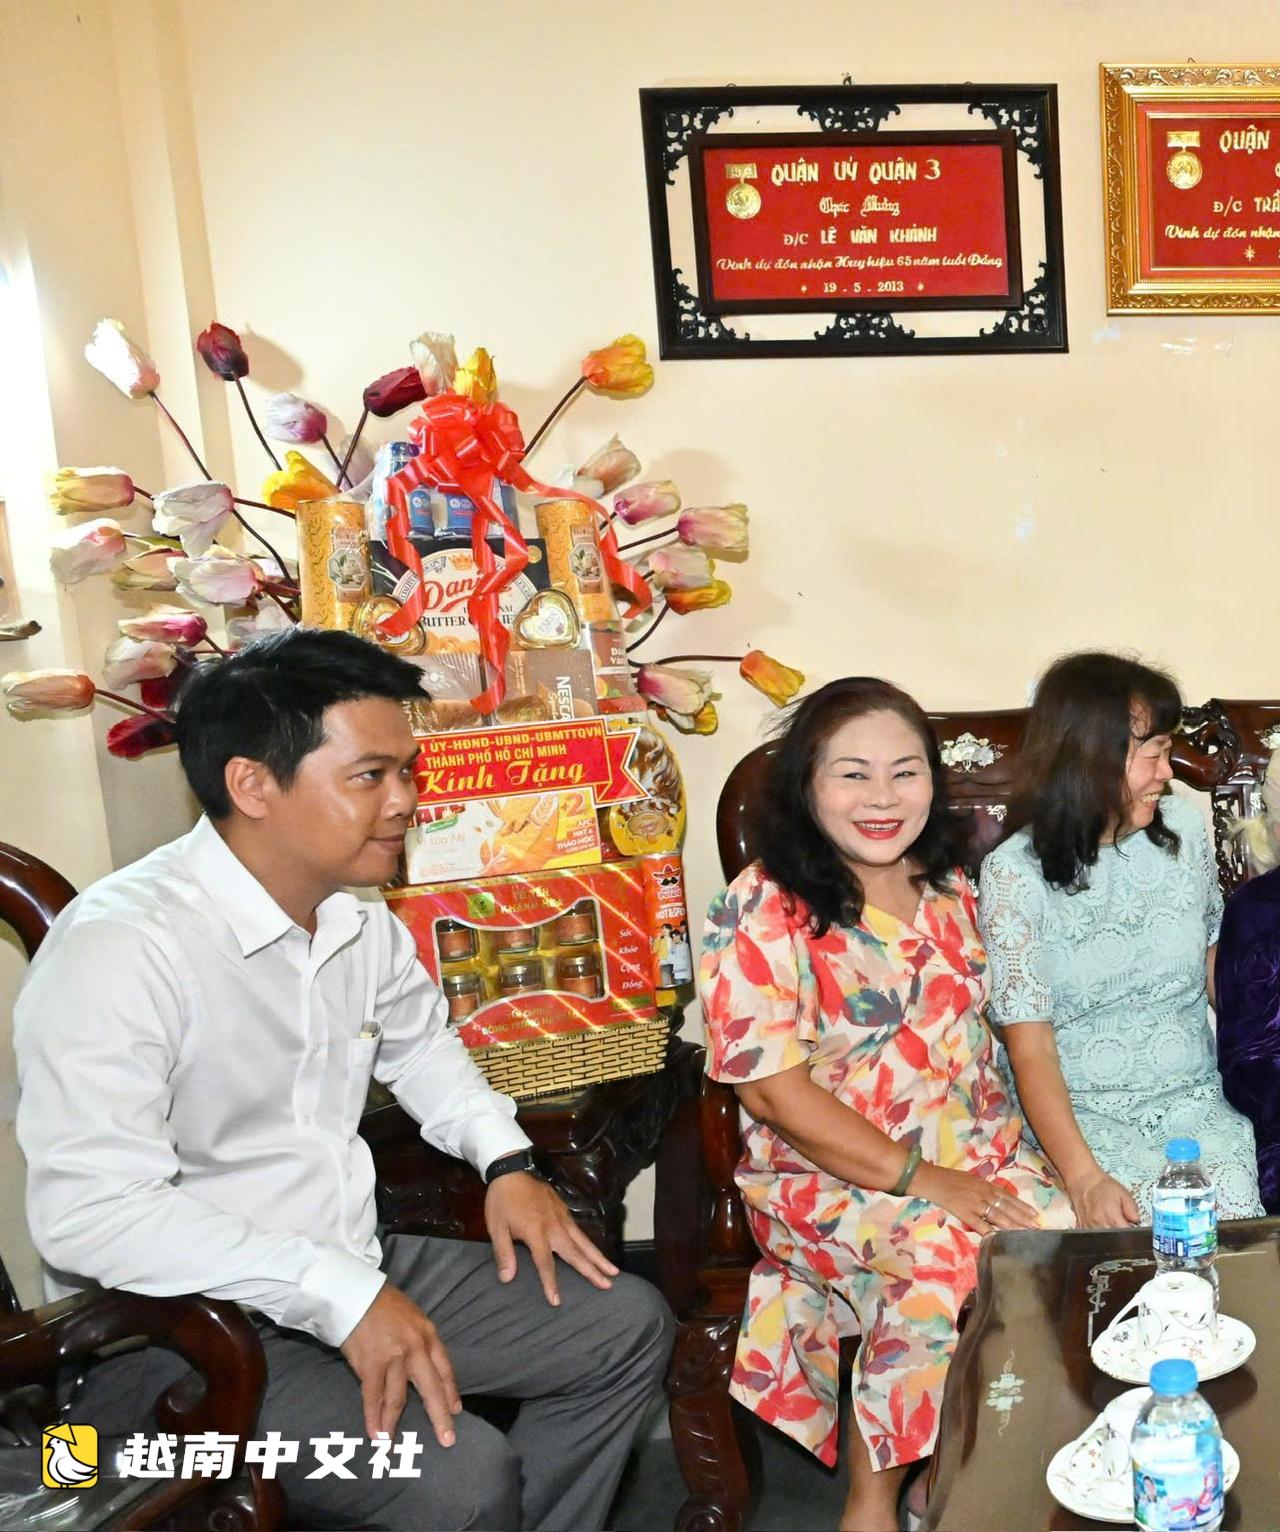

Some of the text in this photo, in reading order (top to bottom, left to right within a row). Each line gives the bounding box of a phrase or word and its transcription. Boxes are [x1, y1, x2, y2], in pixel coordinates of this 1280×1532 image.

[1220, 124, 1270, 154] QUẬN
[771, 157, 819, 186] QUẬN
[869, 157, 917, 184] QUẬN
[924, 159, 941, 180] 3
[1213, 196, 1243, 217] Đ/C
[821, 226, 837, 244] LÊ
[851, 226, 877, 243] VĂN
[889, 224, 937, 243] KHÁNH
[1165, 225, 1200, 238] Vinh
[897, 256, 912, 266] 65
[823, 282, 837, 293] 19
[853, 282, 861, 293] 5
[877, 281, 904, 293] 2013
[556, 676, 573, 719] NESCA
[425, 754, 464, 769] THÀNH
[468, 747, 491, 764] PHỐ
[515, 745, 534, 760] CHÍ
[538, 744, 567, 757] MINH
[417, 760, 584, 795] Kính Tặng
